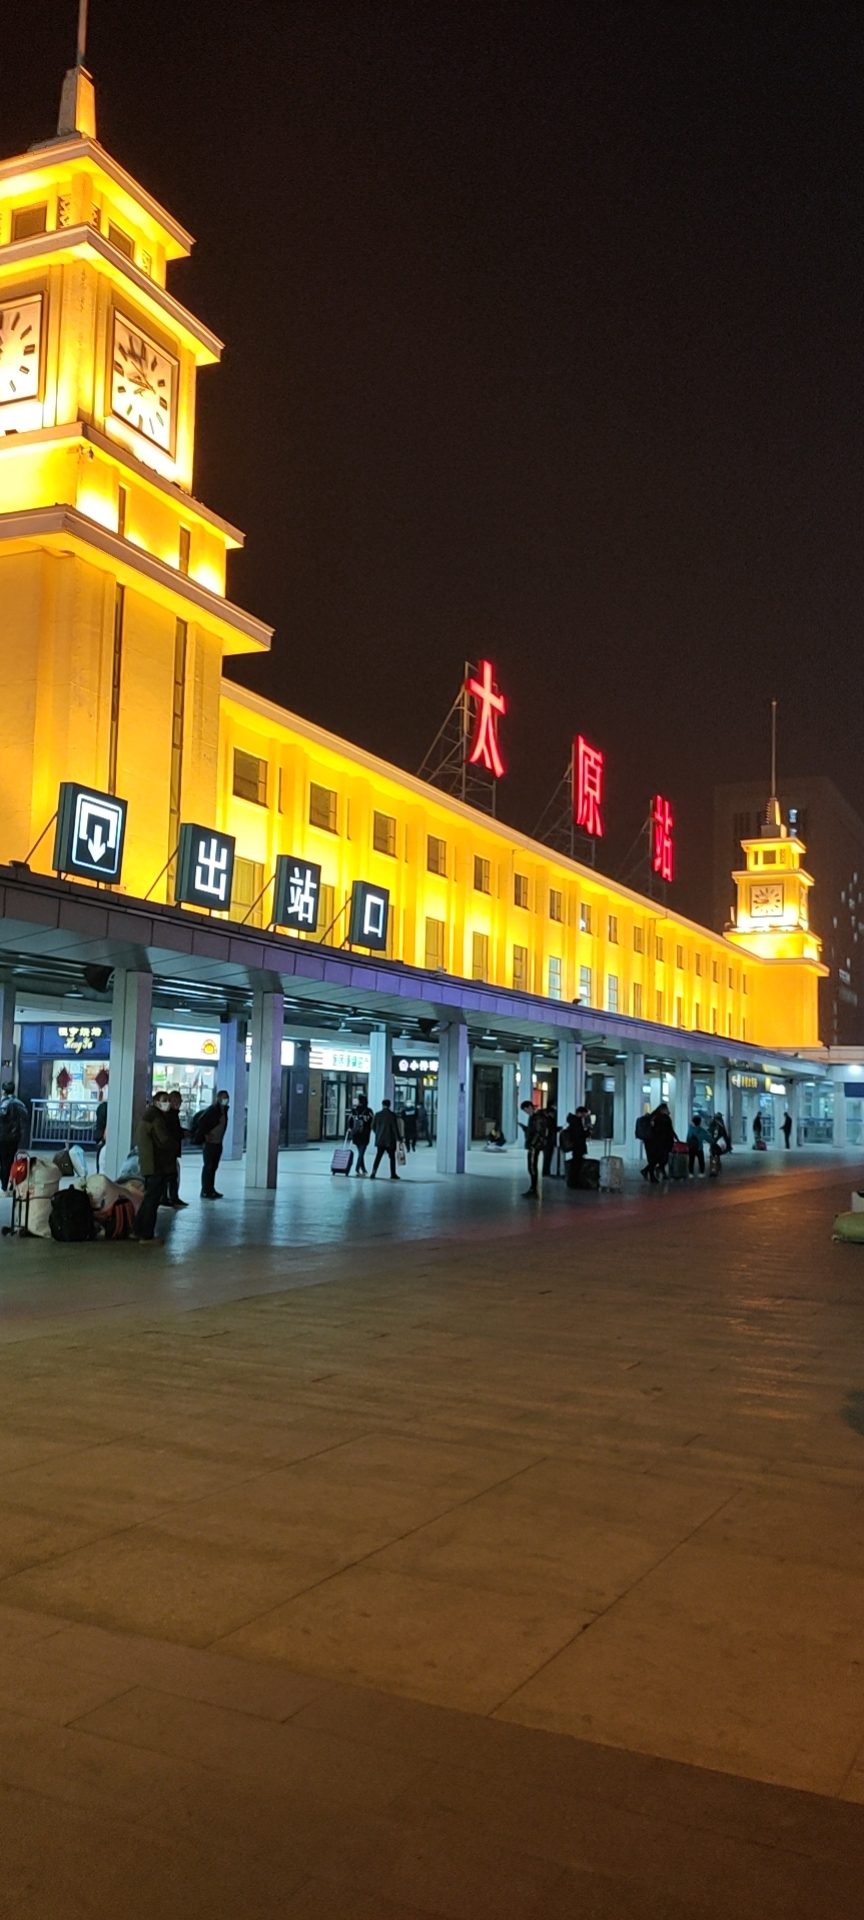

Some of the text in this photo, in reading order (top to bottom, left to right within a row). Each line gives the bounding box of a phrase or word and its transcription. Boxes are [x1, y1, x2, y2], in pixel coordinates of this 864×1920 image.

[467, 659, 674, 883] 太原站
[194, 838, 385, 939] 出站口
